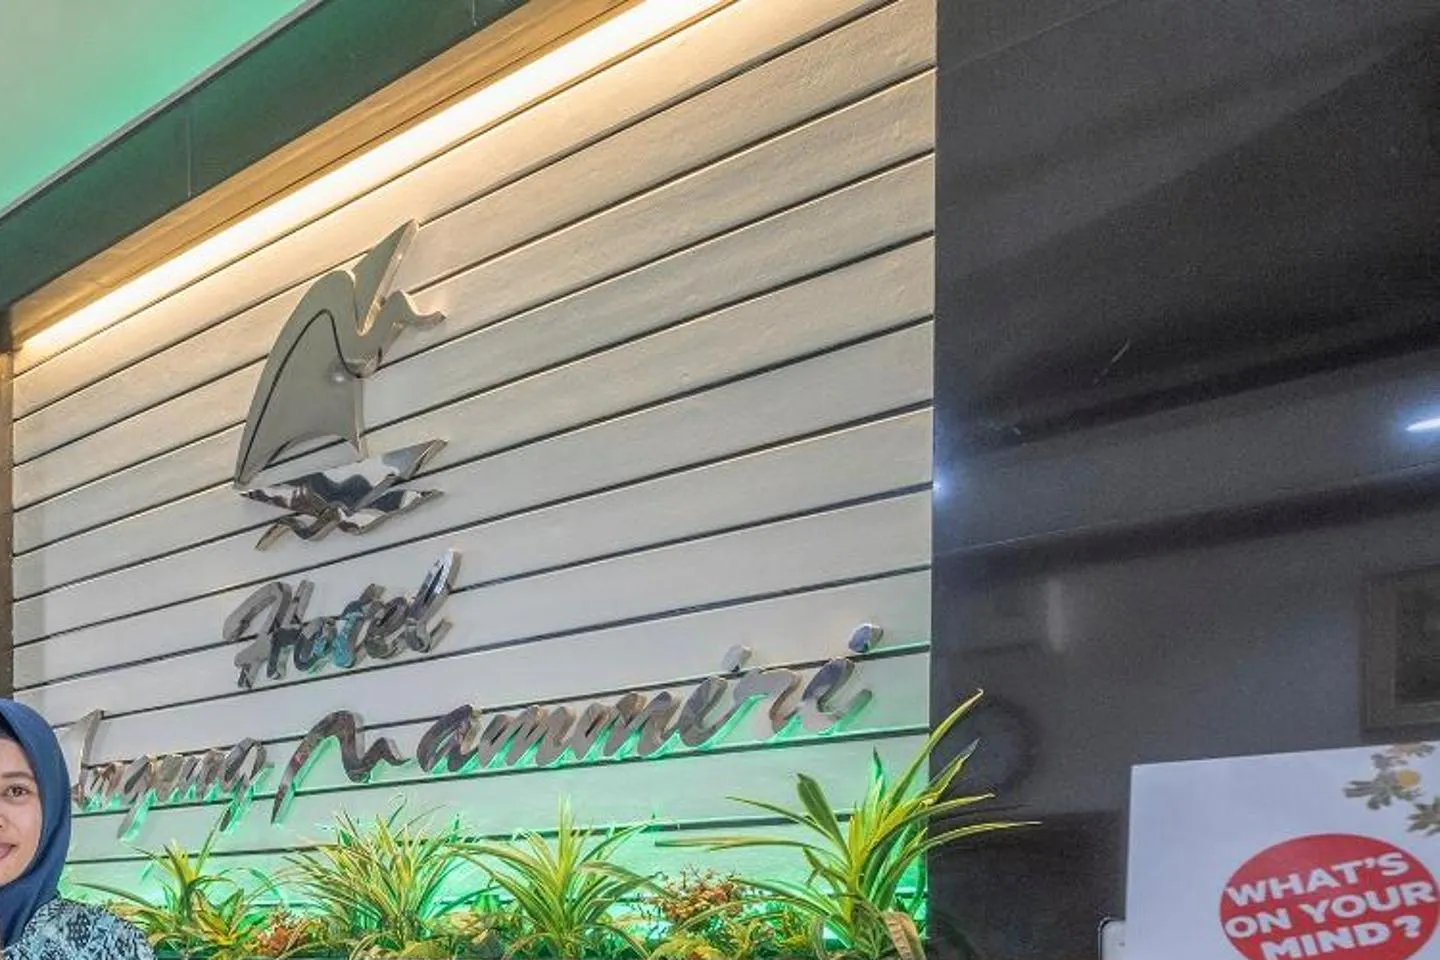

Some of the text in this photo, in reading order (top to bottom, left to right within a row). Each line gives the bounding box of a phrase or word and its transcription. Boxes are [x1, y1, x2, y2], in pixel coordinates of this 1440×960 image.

[222, 548, 456, 688] Hotel
[1226, 851, 1409, 907] WHAT'S
[1224, 880, 1437, 938] ON YOUR
